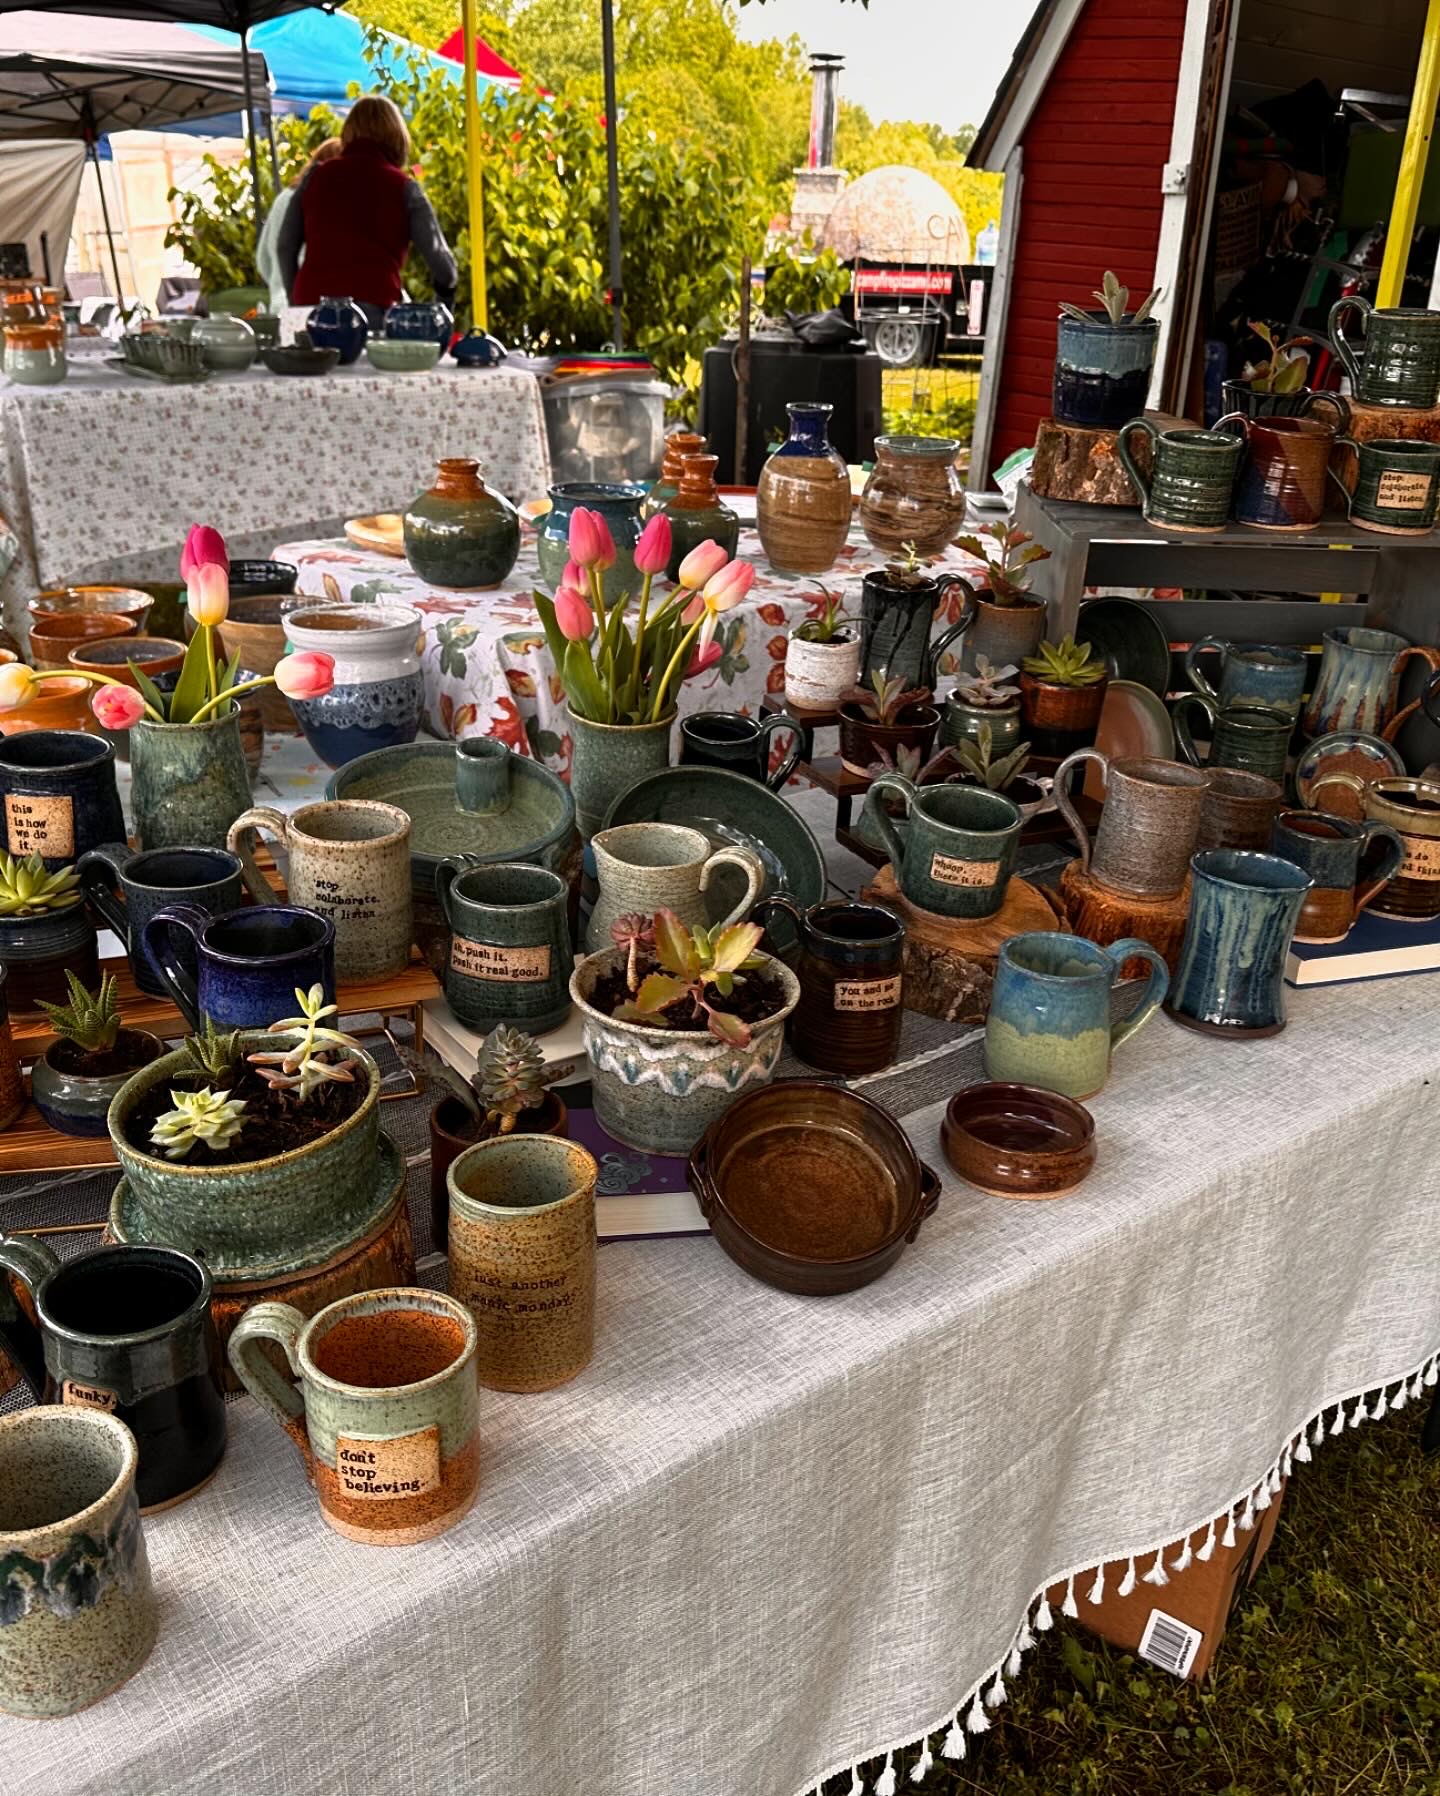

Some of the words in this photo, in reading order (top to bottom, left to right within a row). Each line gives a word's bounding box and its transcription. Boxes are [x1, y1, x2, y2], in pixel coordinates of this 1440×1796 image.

[12, 804, 32, 814] this
[15, 817, 23, 826] is
[26, 819, 47, 828] how
[33, 830, 47, 839] do
[20, 840, 33, 850] it.
[1414, 852, 1429, 860] do
[493, 951, 508, 962] it.
[486, 966, 509, 975] real
[511, 967, 544, 978] good.
[840, 986, 860, 995] you
[863, 984, 882, 994] and
[511, 1276, 567, 1290] another
[470, 1293, 511, 1311] manic
[69, 1383, 116, 1405] funky.
[340, 1450, 376, 1464] don't
[341, 1465, 376, 1480] stop
[344, 1478, 425, 1493] believing.
